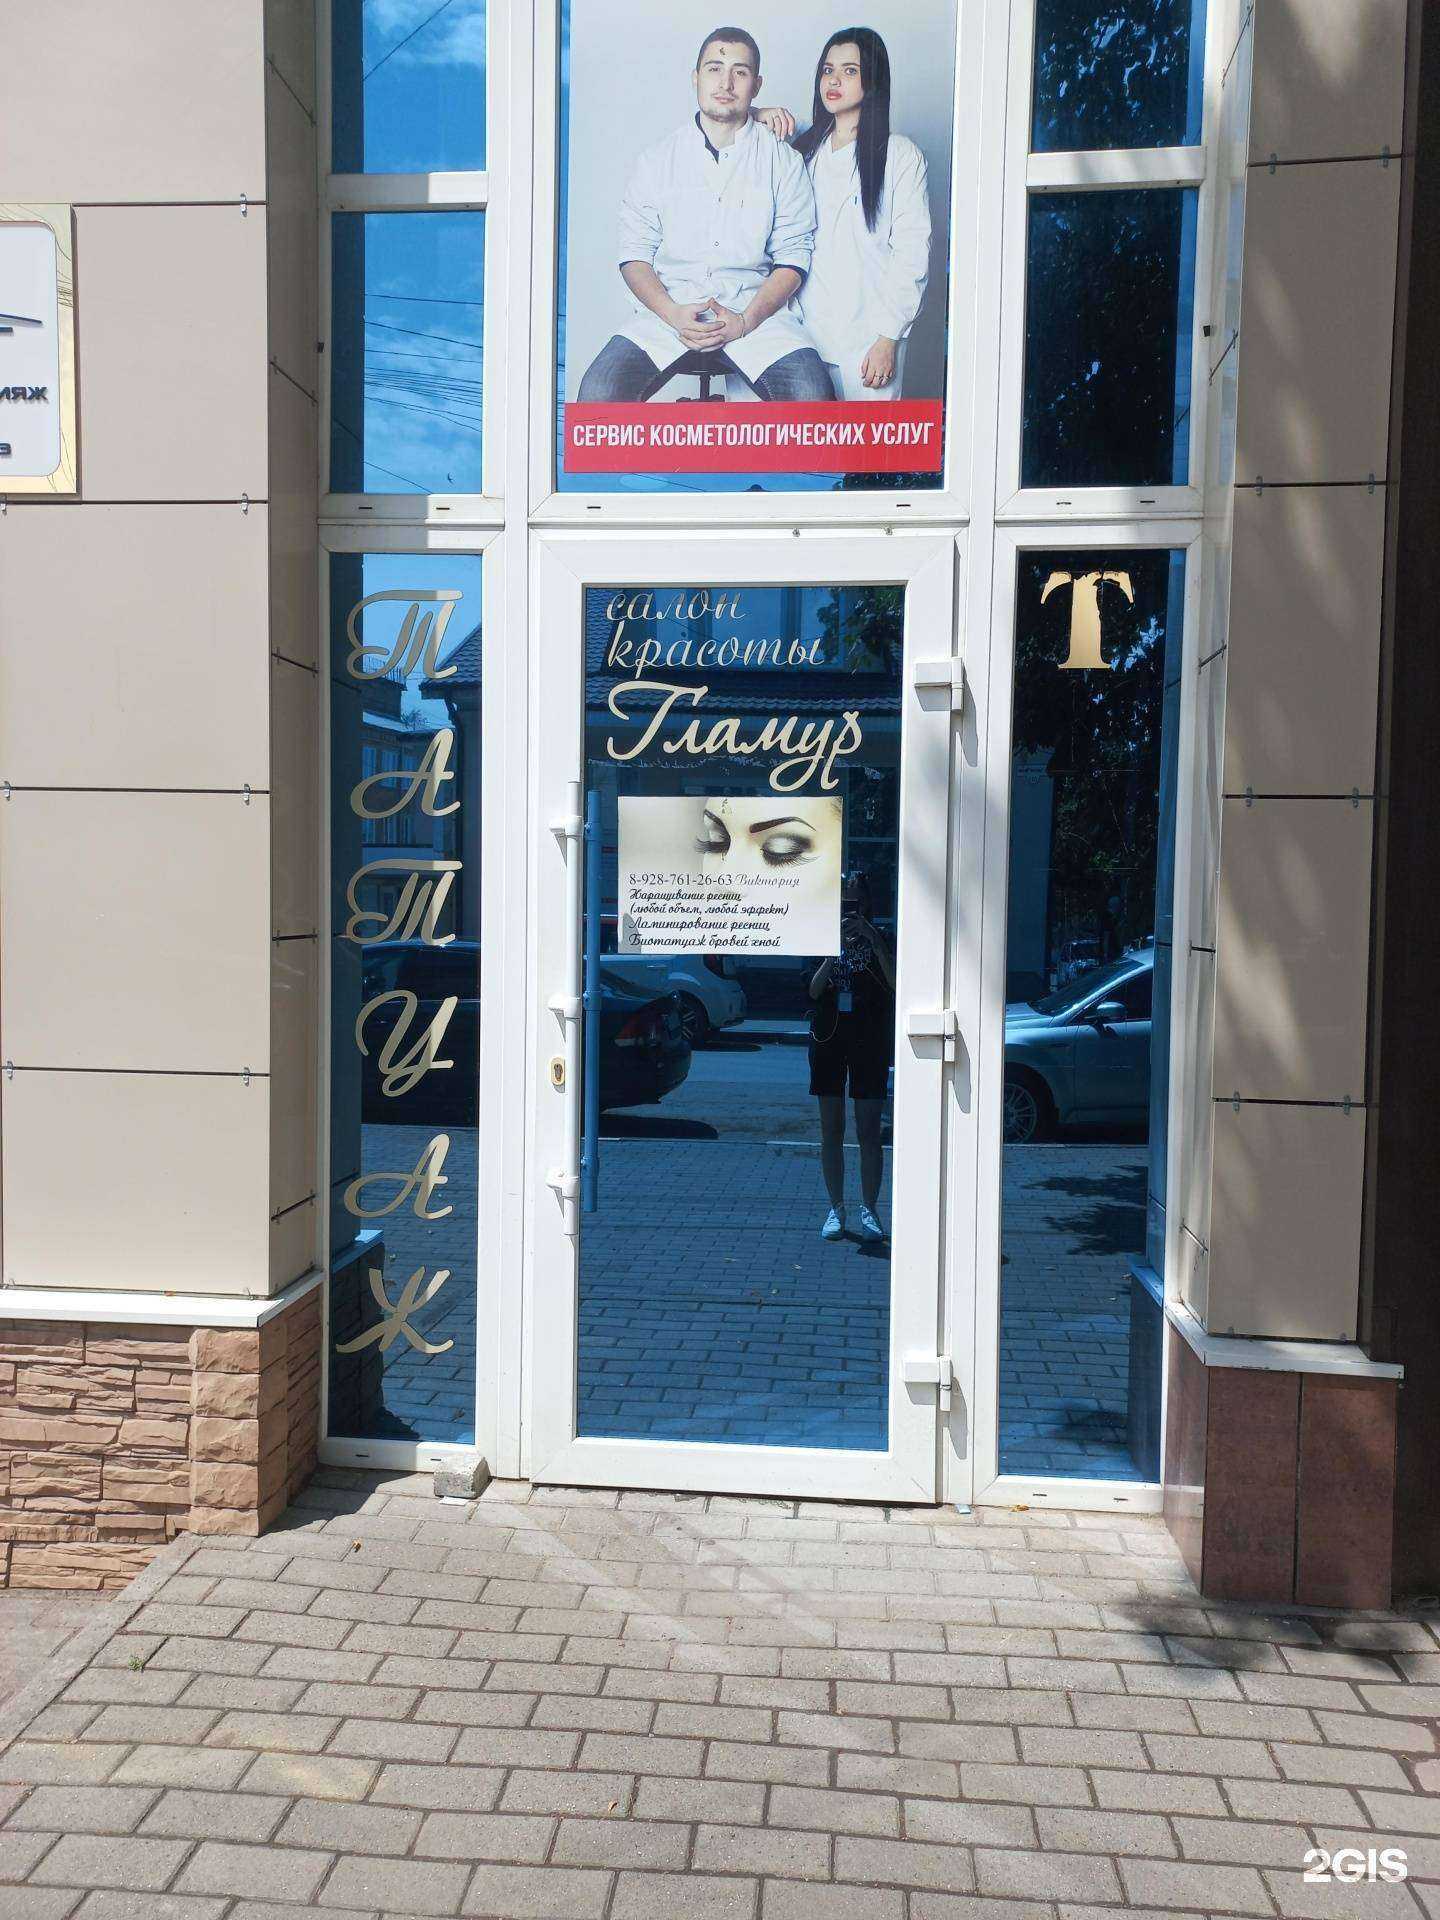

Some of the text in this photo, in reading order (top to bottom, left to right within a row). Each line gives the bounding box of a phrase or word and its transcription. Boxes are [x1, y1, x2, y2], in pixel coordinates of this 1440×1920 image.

[573, 422, 934, 447] СЕРВИС КОСМЕТОЛОГИЧЕСКИХ УСЛУГ
[605, 589, 746, 621] салон
[607, 619, 825, 679] красоты
[605, 680, 863, 792] Гламур
[629, 873, 800, 888] 8-928-761-26-63 Виктория
[629, 888, 742, 902] Наращивание ресниц
[630, 903, 667, 915] (любой
[704, 903, 738, 914] любой
[740, 903, 790, 916] эффект)
[628, 916, 770, 931] Ламинирование ресниц
[628, 933, 781, 948] Биотатуаж бровей хной
